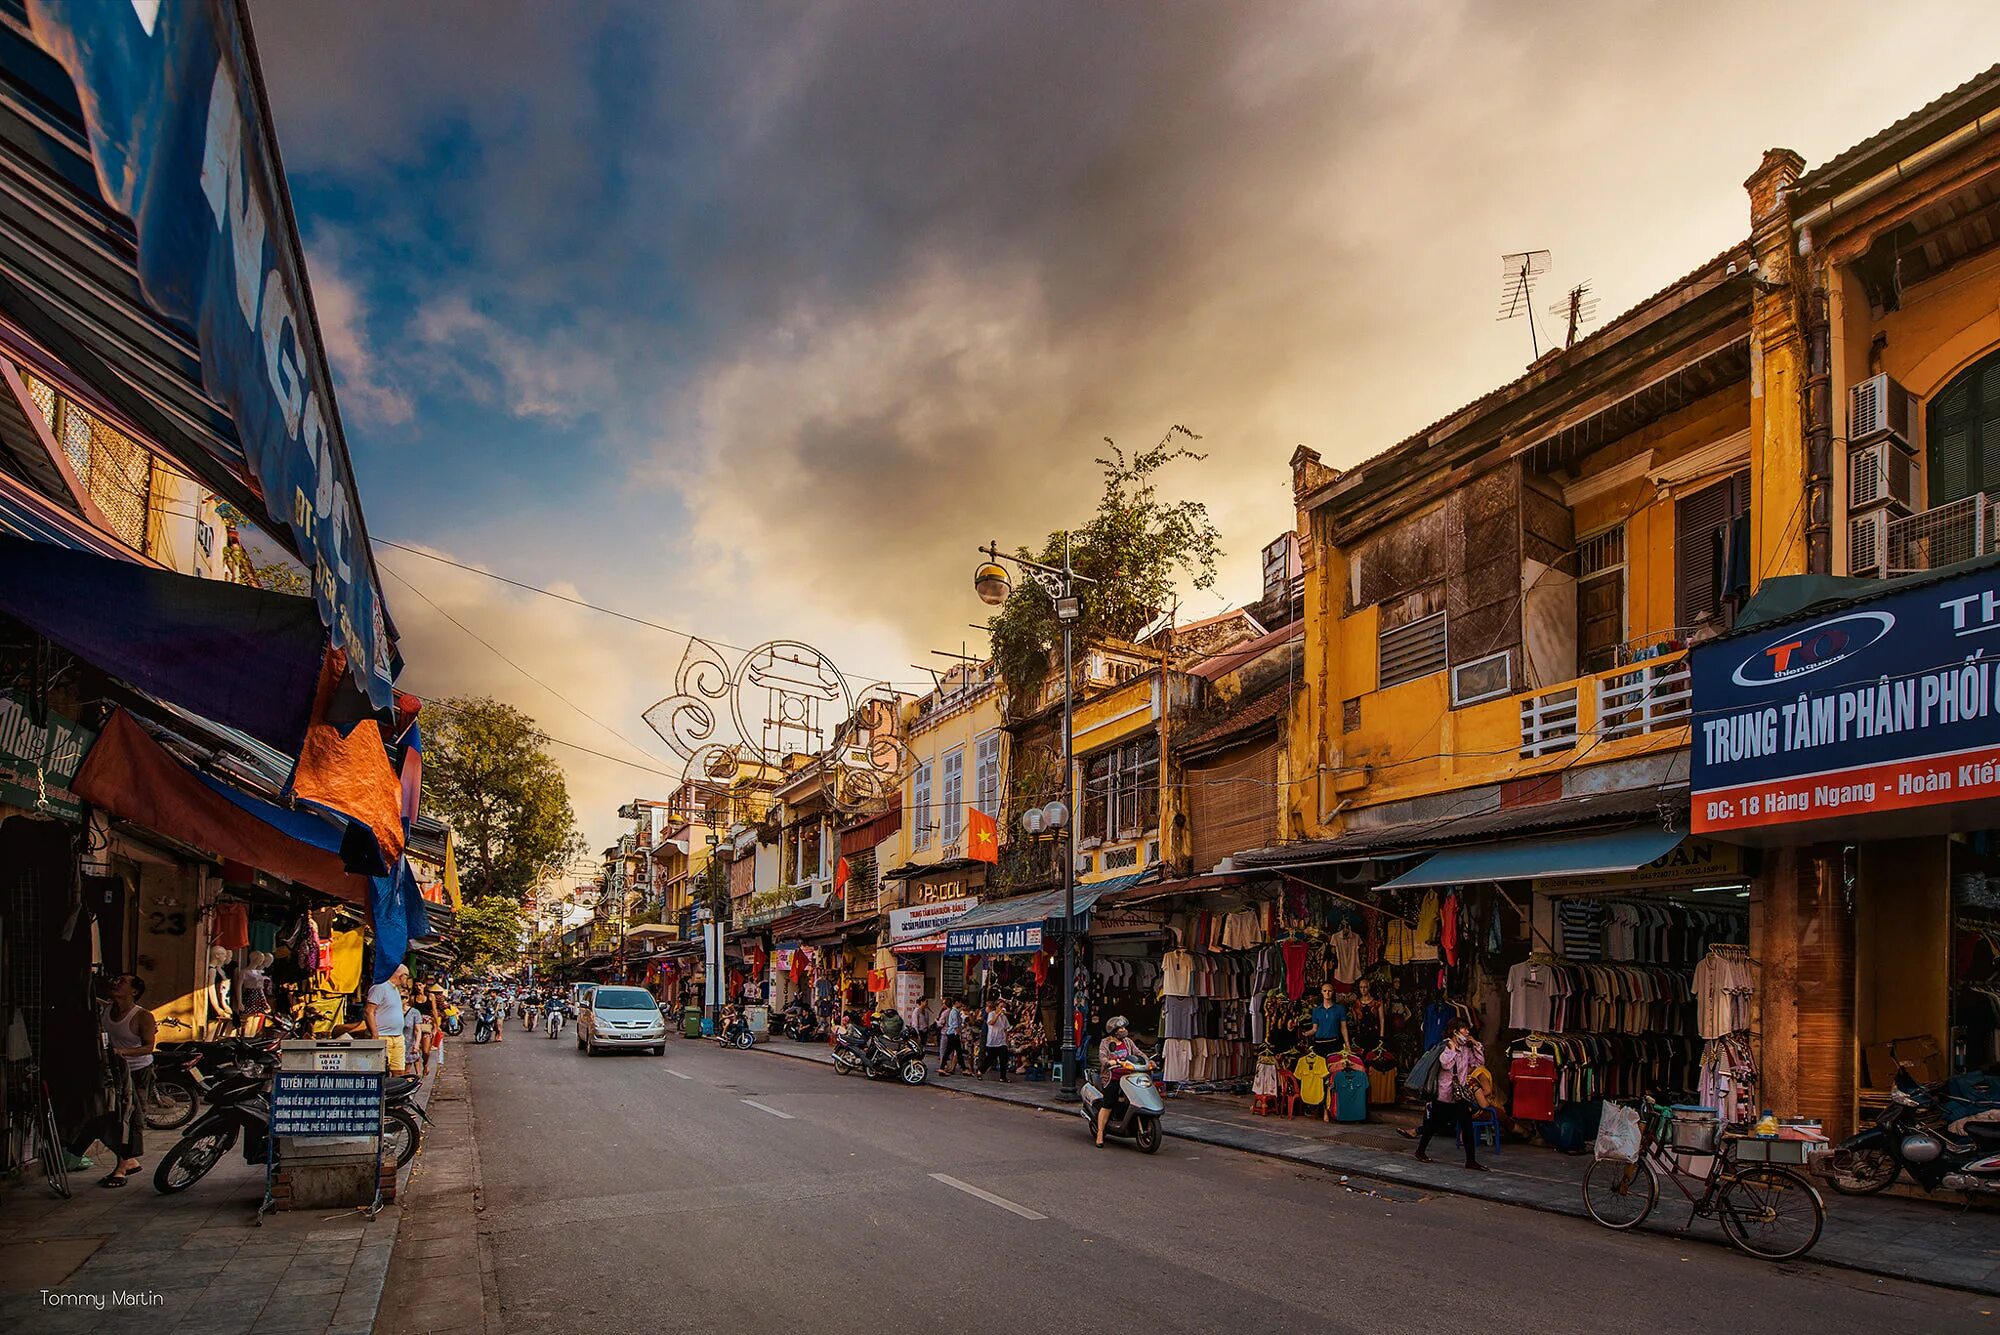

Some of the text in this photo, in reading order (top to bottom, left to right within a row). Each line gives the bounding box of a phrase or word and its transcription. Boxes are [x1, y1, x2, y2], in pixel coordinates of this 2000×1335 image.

[1703, 707, 1778, 766] TRUNG
[1782, 692, 1836, 752] TÂM
[1839, 675, 1915, 742] PHÂN
[1920, 648, 1988, 728] PHỐI
[1706, 802, 1735, 821] ĐC:
[1739, 797, 1760, 816] 18
[1764, 790, 1809, 814] Hàng
[1814, 780, 1876, 808] Ngang
[1898, 768, 1951, 796] Hoàn
[149, 911, 186, 936] 23
[959, 932, 974, 945] HÀNG
[976, 929, 1004, 950] HỒNG
[1006, 926, 1025, 948] HẢI
[280, 1074, 303, 1089] TUYẾN
[304, 1074, 319, 1089] PHỐ
[320, 1075, 334, 1089] VĂN
[335, 1078, 354, 1089] MINH
